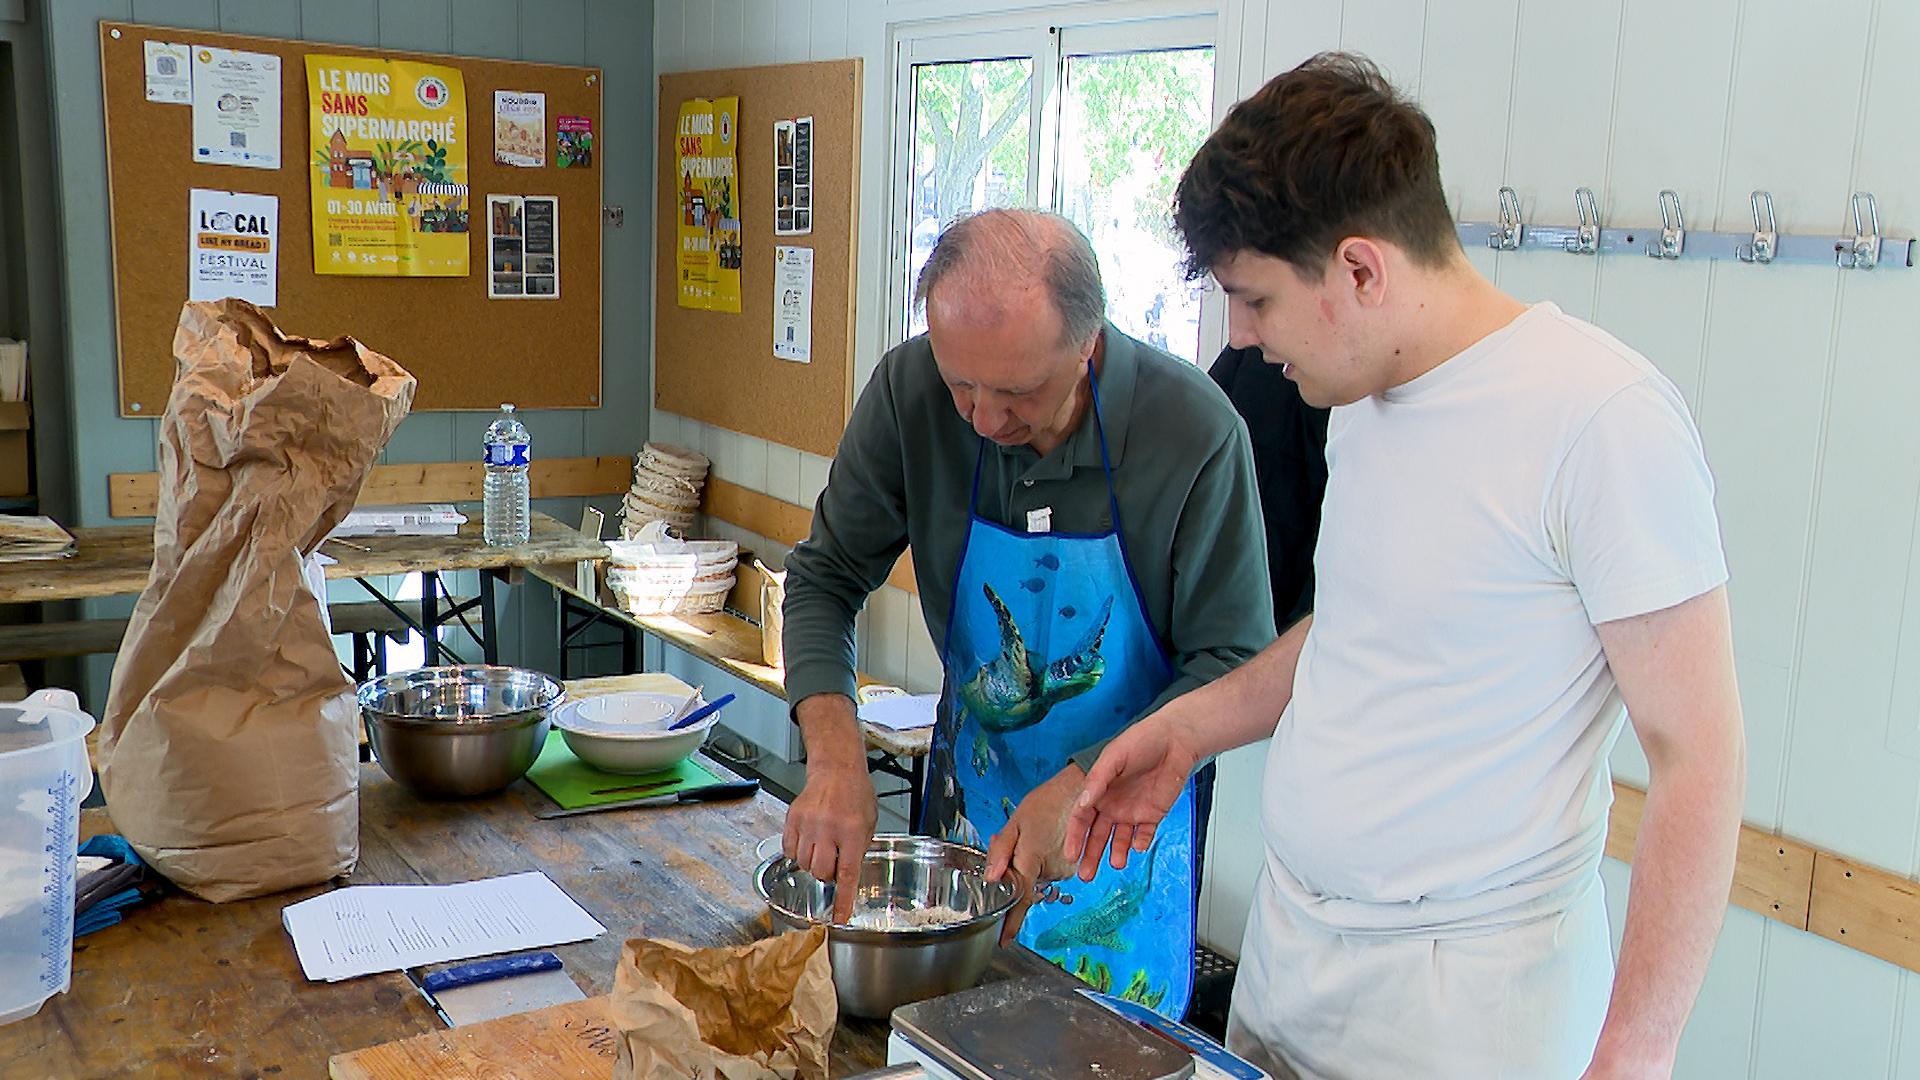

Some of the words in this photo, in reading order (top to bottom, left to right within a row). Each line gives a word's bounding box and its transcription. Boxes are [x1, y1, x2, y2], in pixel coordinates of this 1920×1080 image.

[319, 68, 342, 92] LE
[346, 70, 391, 96] MOIS
[321, 92, 368, 116] SANS
[322, 114, 457, 144] SUPERMARCHÉ
[680, 114, 690, 135] LE
[691, 113, 713, 135] MOIS
[680, 136, 703, 156] SANS
[365, 200, 399, 217] AVRIL
[200, 210, 269, 235] LOCAL
[200, 253, 267, 270] FESTIVAL
